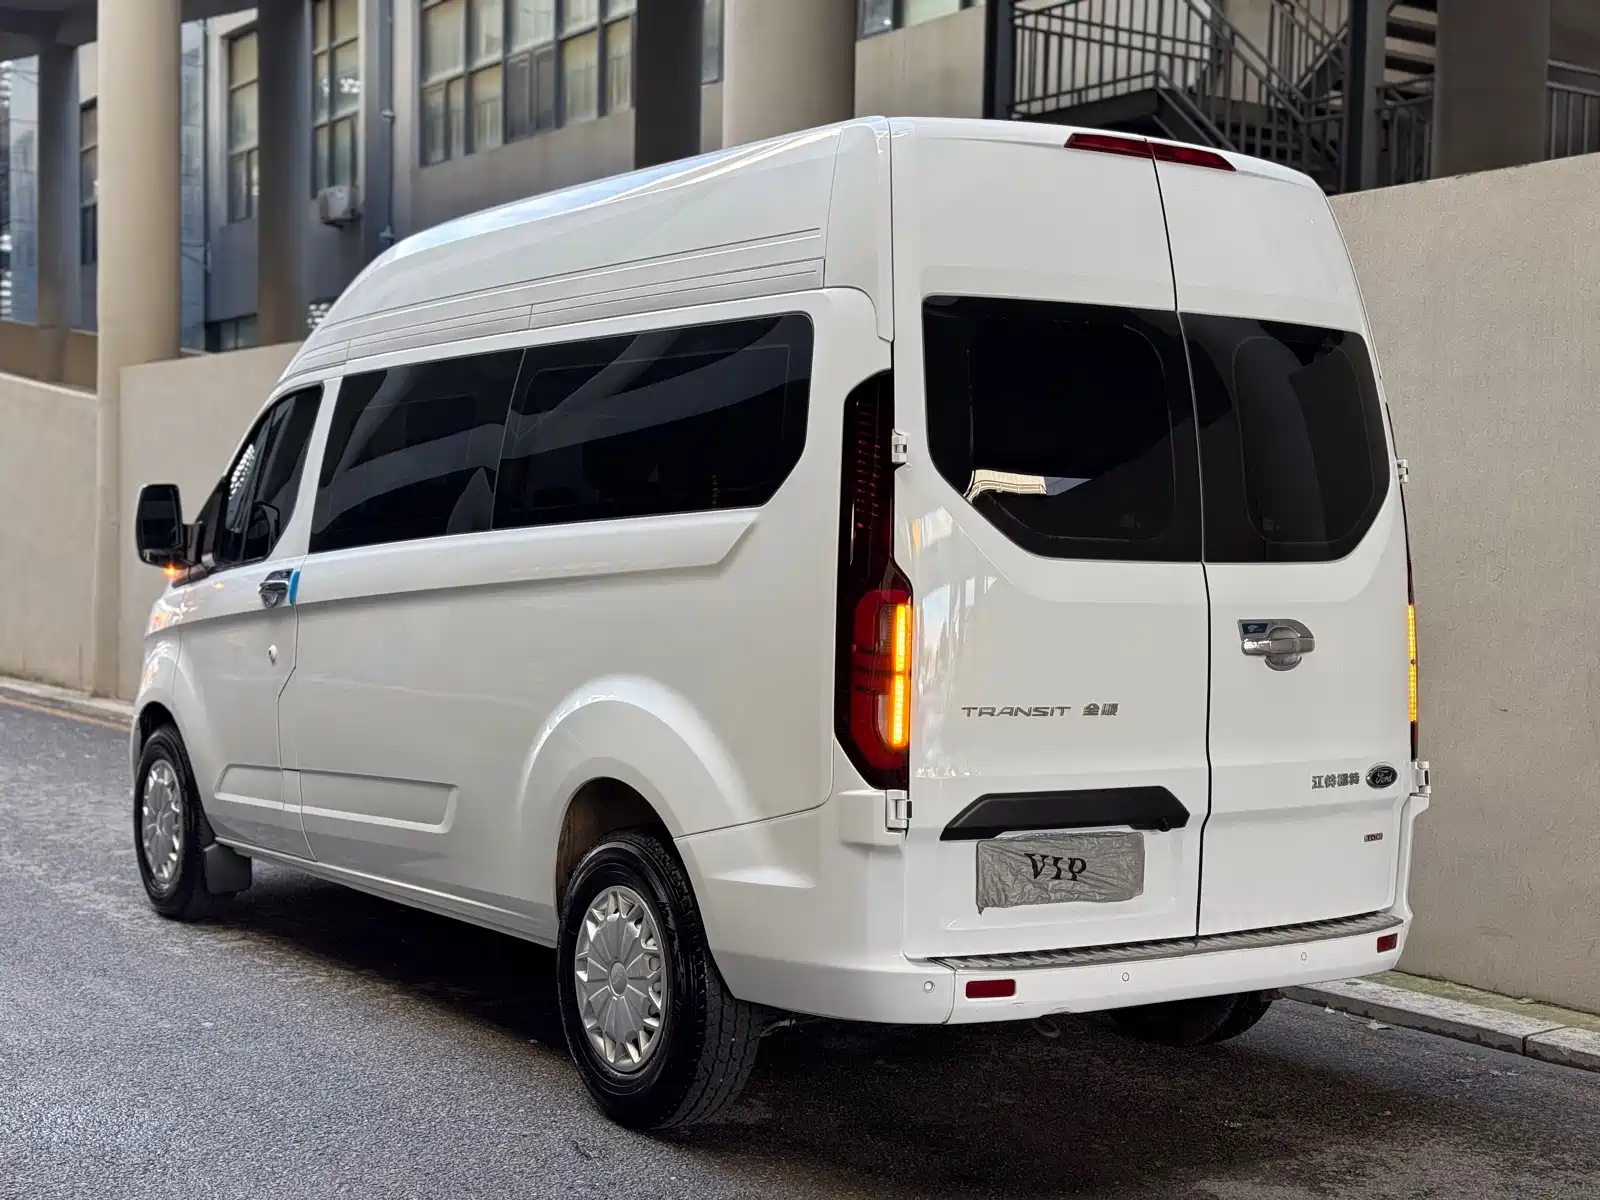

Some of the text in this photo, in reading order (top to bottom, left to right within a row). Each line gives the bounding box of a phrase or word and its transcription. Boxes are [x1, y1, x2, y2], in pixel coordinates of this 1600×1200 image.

[961, 706, 1071, 717] TRANSIT
[1083, 702, 1119, 716] 全顺
[1311, 772, 1360, 790] 江铃福特
[1024, 852, 1087, 881] VIP
